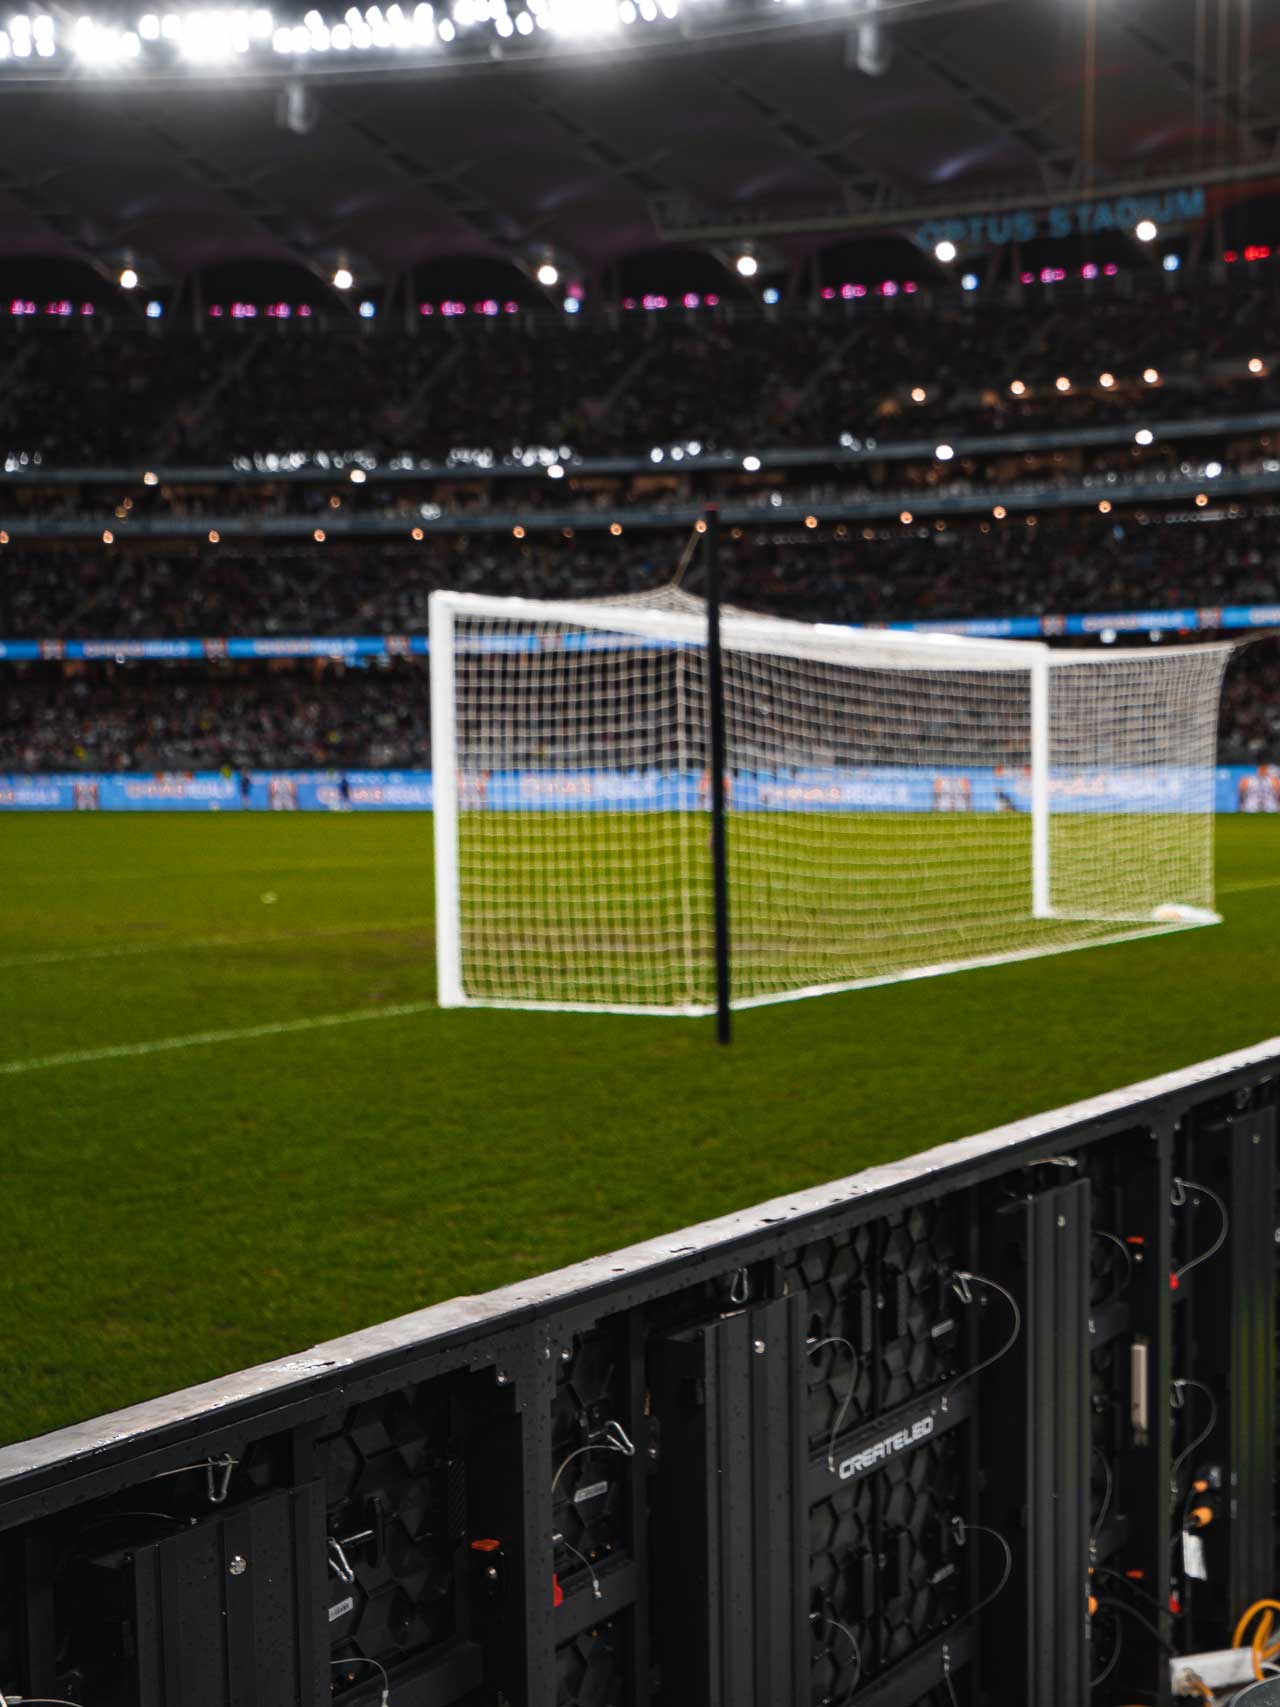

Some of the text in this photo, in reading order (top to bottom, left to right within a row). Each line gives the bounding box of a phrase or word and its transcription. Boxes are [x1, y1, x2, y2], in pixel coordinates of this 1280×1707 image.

[915, 189, 1205, 250] OPTUS STADIUM
[839, 1415, 934, 1480] CREATELED
